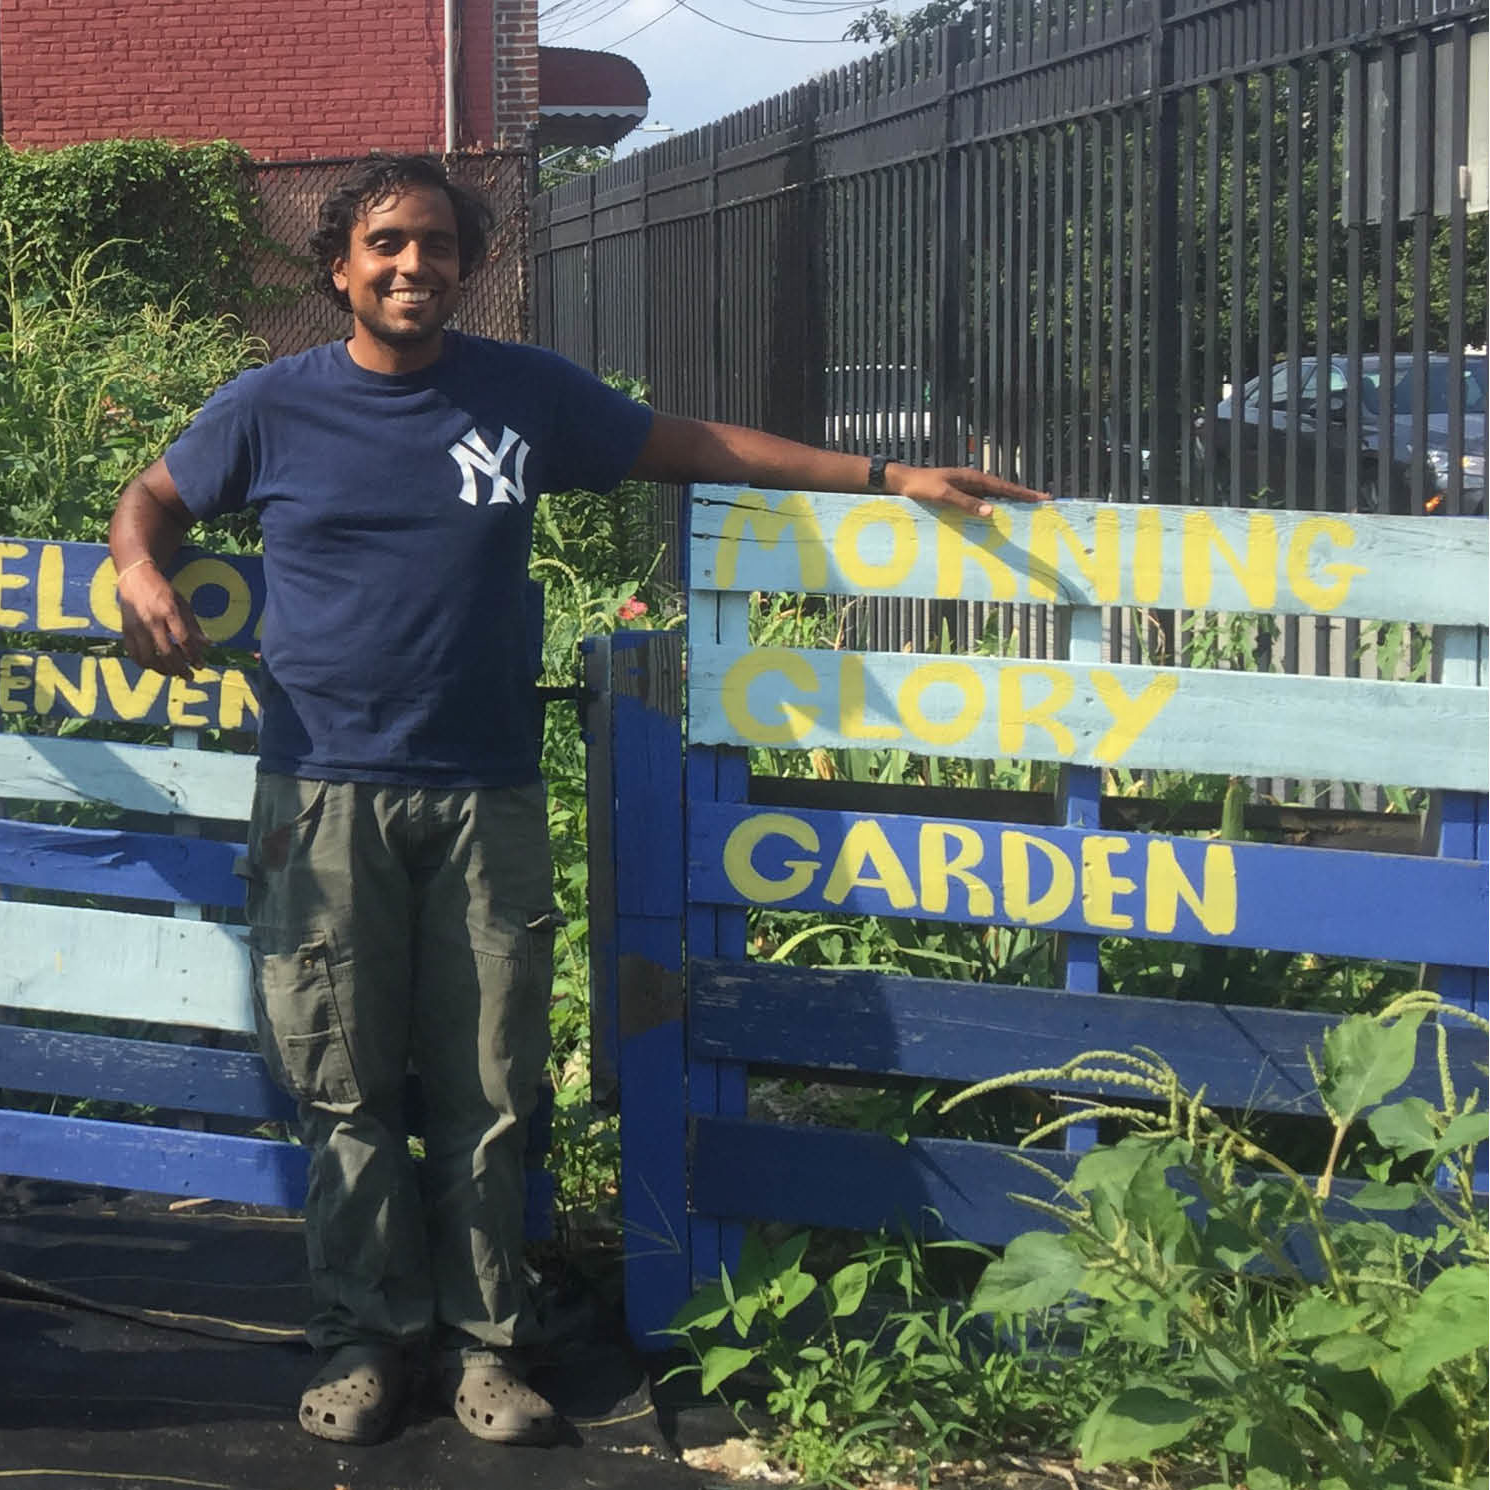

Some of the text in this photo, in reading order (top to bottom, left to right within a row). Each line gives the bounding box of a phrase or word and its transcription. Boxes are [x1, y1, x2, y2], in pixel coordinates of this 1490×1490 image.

[447, 424, 531, 507] NY
[716, 492, 1368, 612] MORNING
[720, 649, 1179, 762] GLORY
[723, 815, 1238, 936] GARDEN
